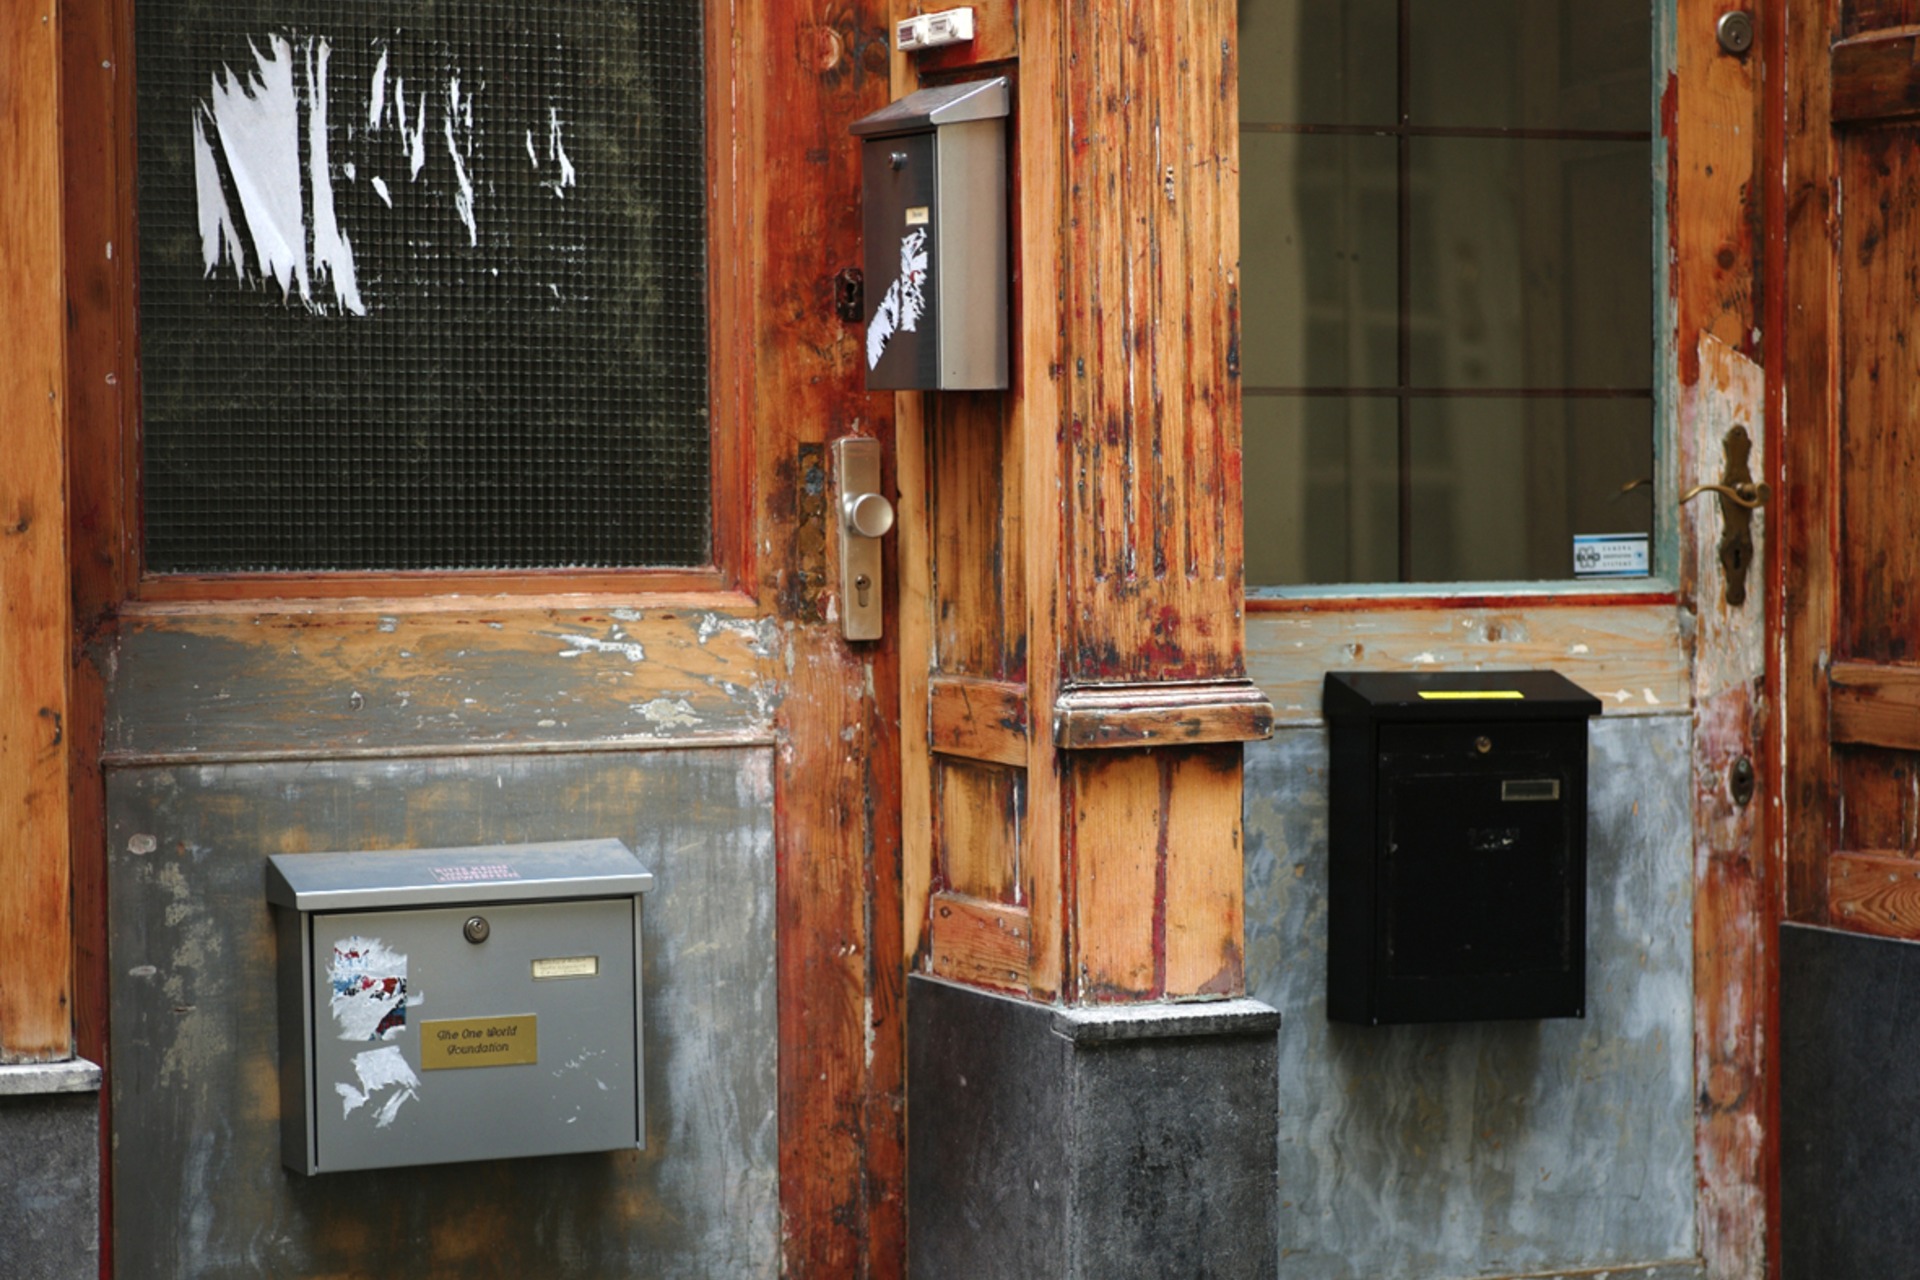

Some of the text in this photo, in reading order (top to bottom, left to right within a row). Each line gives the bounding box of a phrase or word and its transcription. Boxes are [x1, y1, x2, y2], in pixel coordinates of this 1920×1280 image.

[437, 1026, 517, 1040] The One World
[447, 1042, 509, 1055] Foundation
